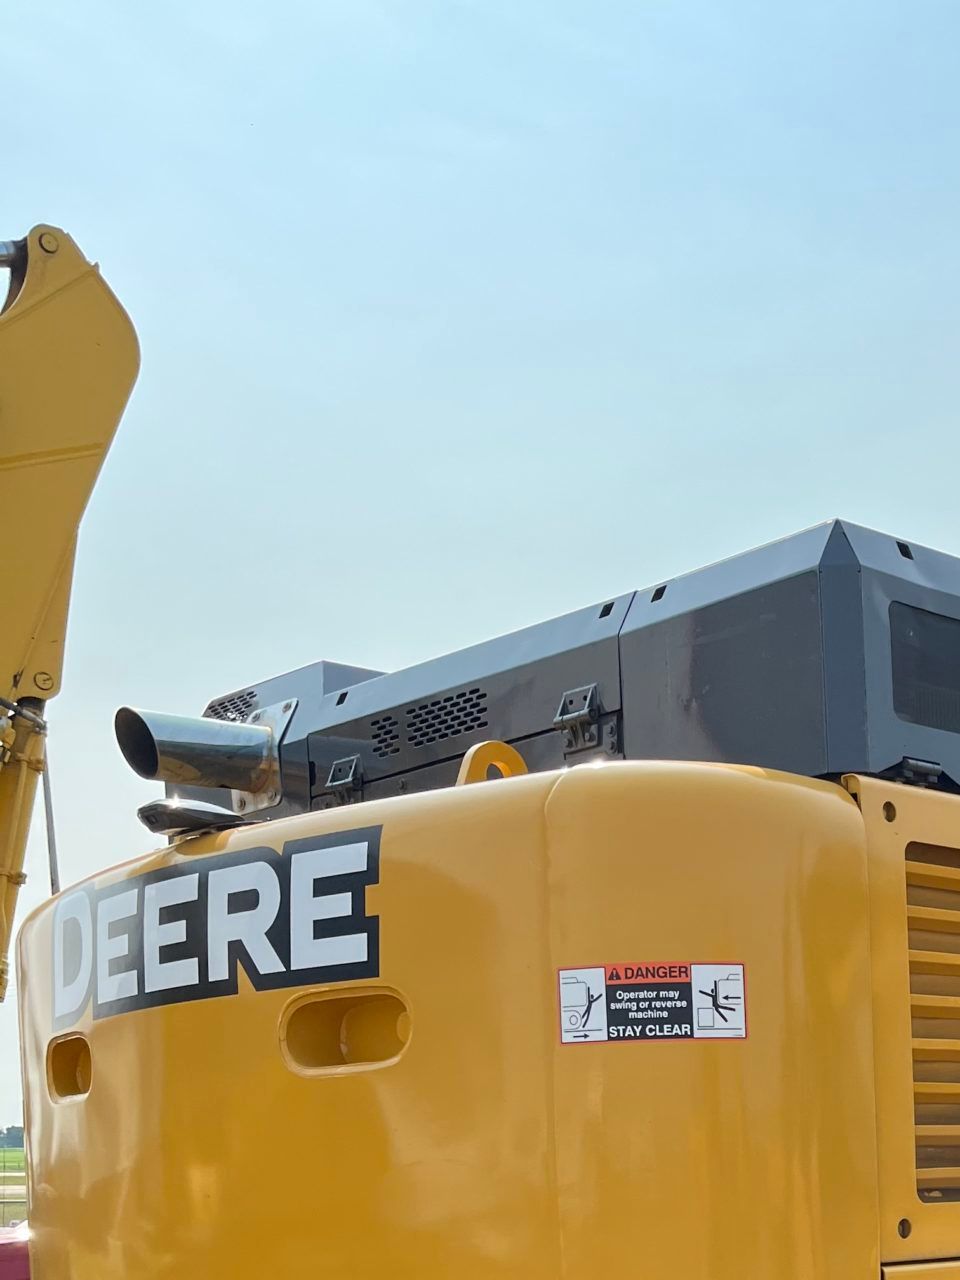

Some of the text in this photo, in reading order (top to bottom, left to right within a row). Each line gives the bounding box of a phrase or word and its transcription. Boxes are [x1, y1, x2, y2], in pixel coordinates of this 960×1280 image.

[54, 841, 368, 1018] DEERE
[624, 966, 689, 980] DANGER
[616, 990, 680, 1000] Operator may
[610, 1000, 688, 1010] swing or reverse
[628, 1010, 669, 1019] machine
[609, 1024, 691, 1037] STAY CLEAR
